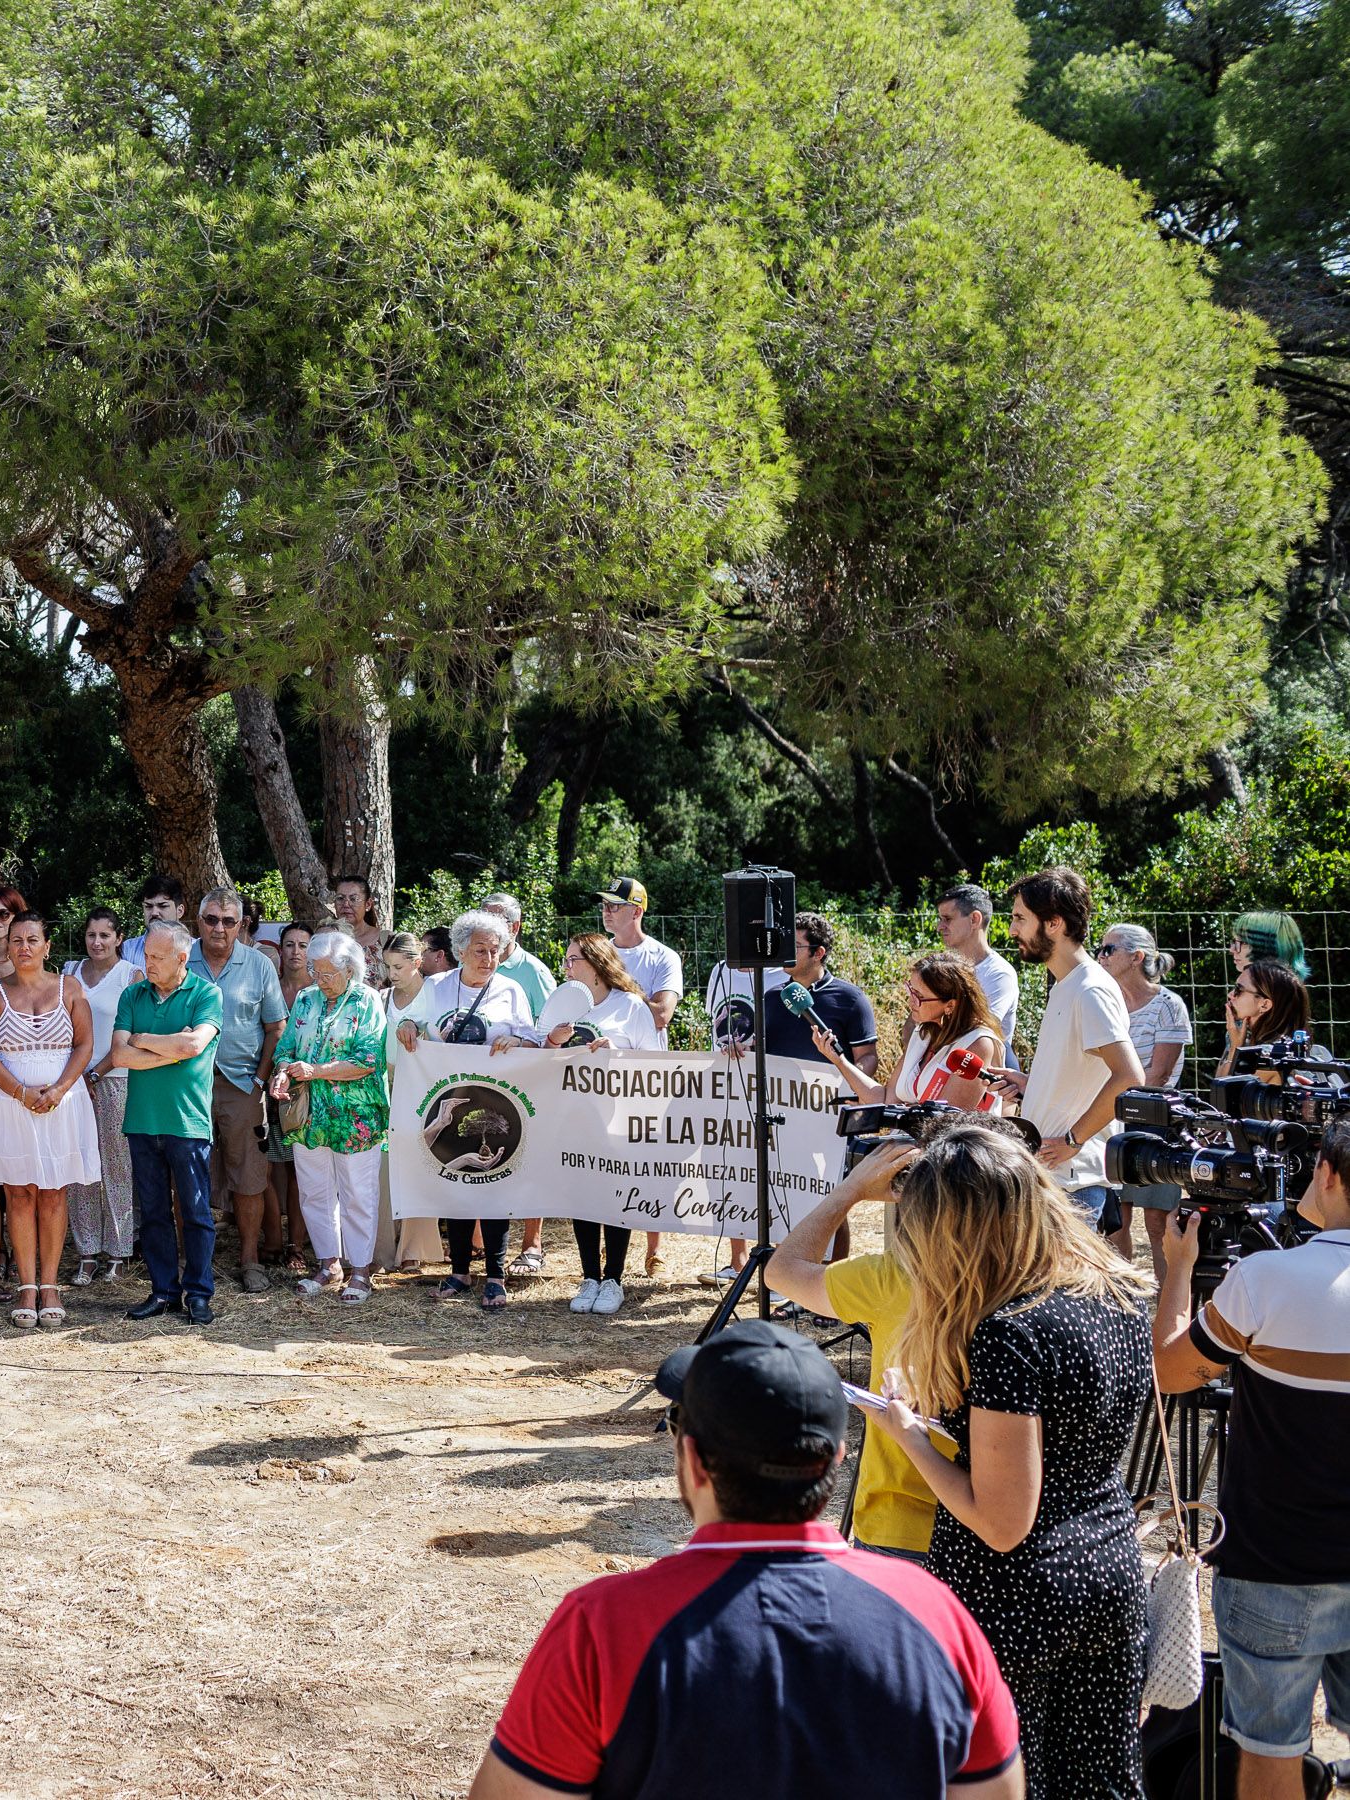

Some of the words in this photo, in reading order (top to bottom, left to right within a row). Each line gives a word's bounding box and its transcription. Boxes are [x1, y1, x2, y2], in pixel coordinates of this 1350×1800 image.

[961, 1053, 974, 1067] rne
[449, 1073, 459, 1083] El
[460, 1073, 497, 1085] Pulmón
[497, 1080, 510, 1089] de
[509, 1085, 520, 1096] la
[562, 1065, 703, 1099] ASOCIACIÓN
[712, 1072, 739, 1101] EL
[628, 1116, 658, 1144] DE
[666, 1117, 695, 1145] LA
[438, 1166, 459, 1183] Las
[461, 1167, 512, 1185] Canteras
[561, 1152, 585, 1168] POR
[588, 1155, 596, 1170] Y
[599, 1158, 630, 1176] PARA
[634, 1161, 650, 1177] LA
[653, 1161, 737, 1182] NATURALEZA
[740, 1167, 756, 1184] DE
[767, 1170, 806, 1192] UERTO
[615, 1187, 667, 1218] "Las
